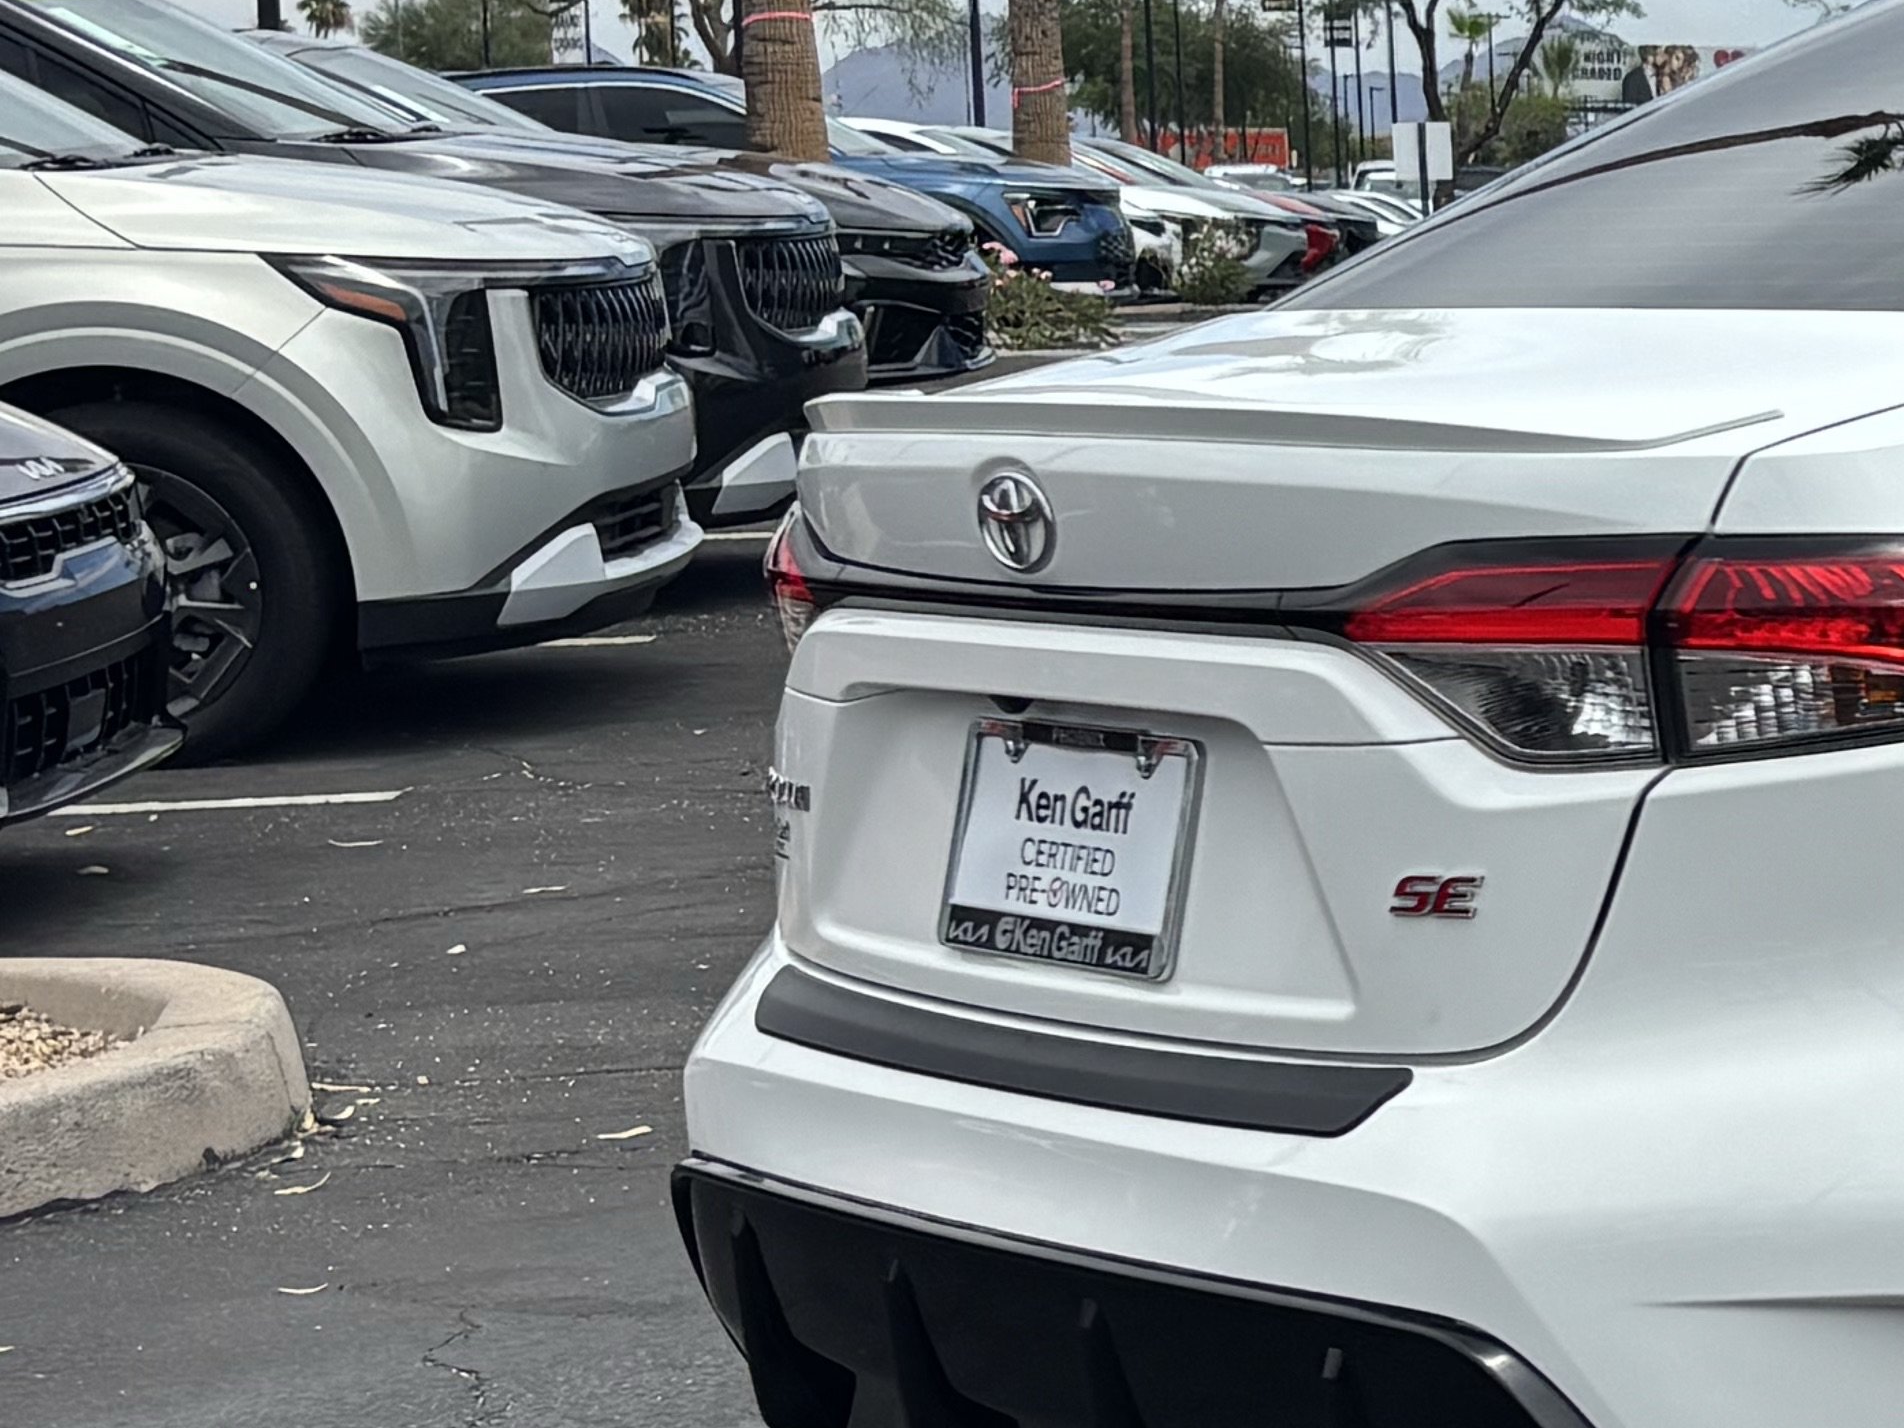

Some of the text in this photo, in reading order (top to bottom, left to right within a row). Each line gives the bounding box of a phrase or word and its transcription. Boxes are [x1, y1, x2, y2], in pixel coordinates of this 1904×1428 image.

[1015, 777, 1136, 835] Ken Garff
[1020, 837, 1115, 877] CERTIFIED
[1004, 872, 1121, 916] PRE-OWNED
[1388, 875, 1485, 919] SE
[1012, 918, 1050, 957] Ken
[1051, 925, 1104, 965] Garff
